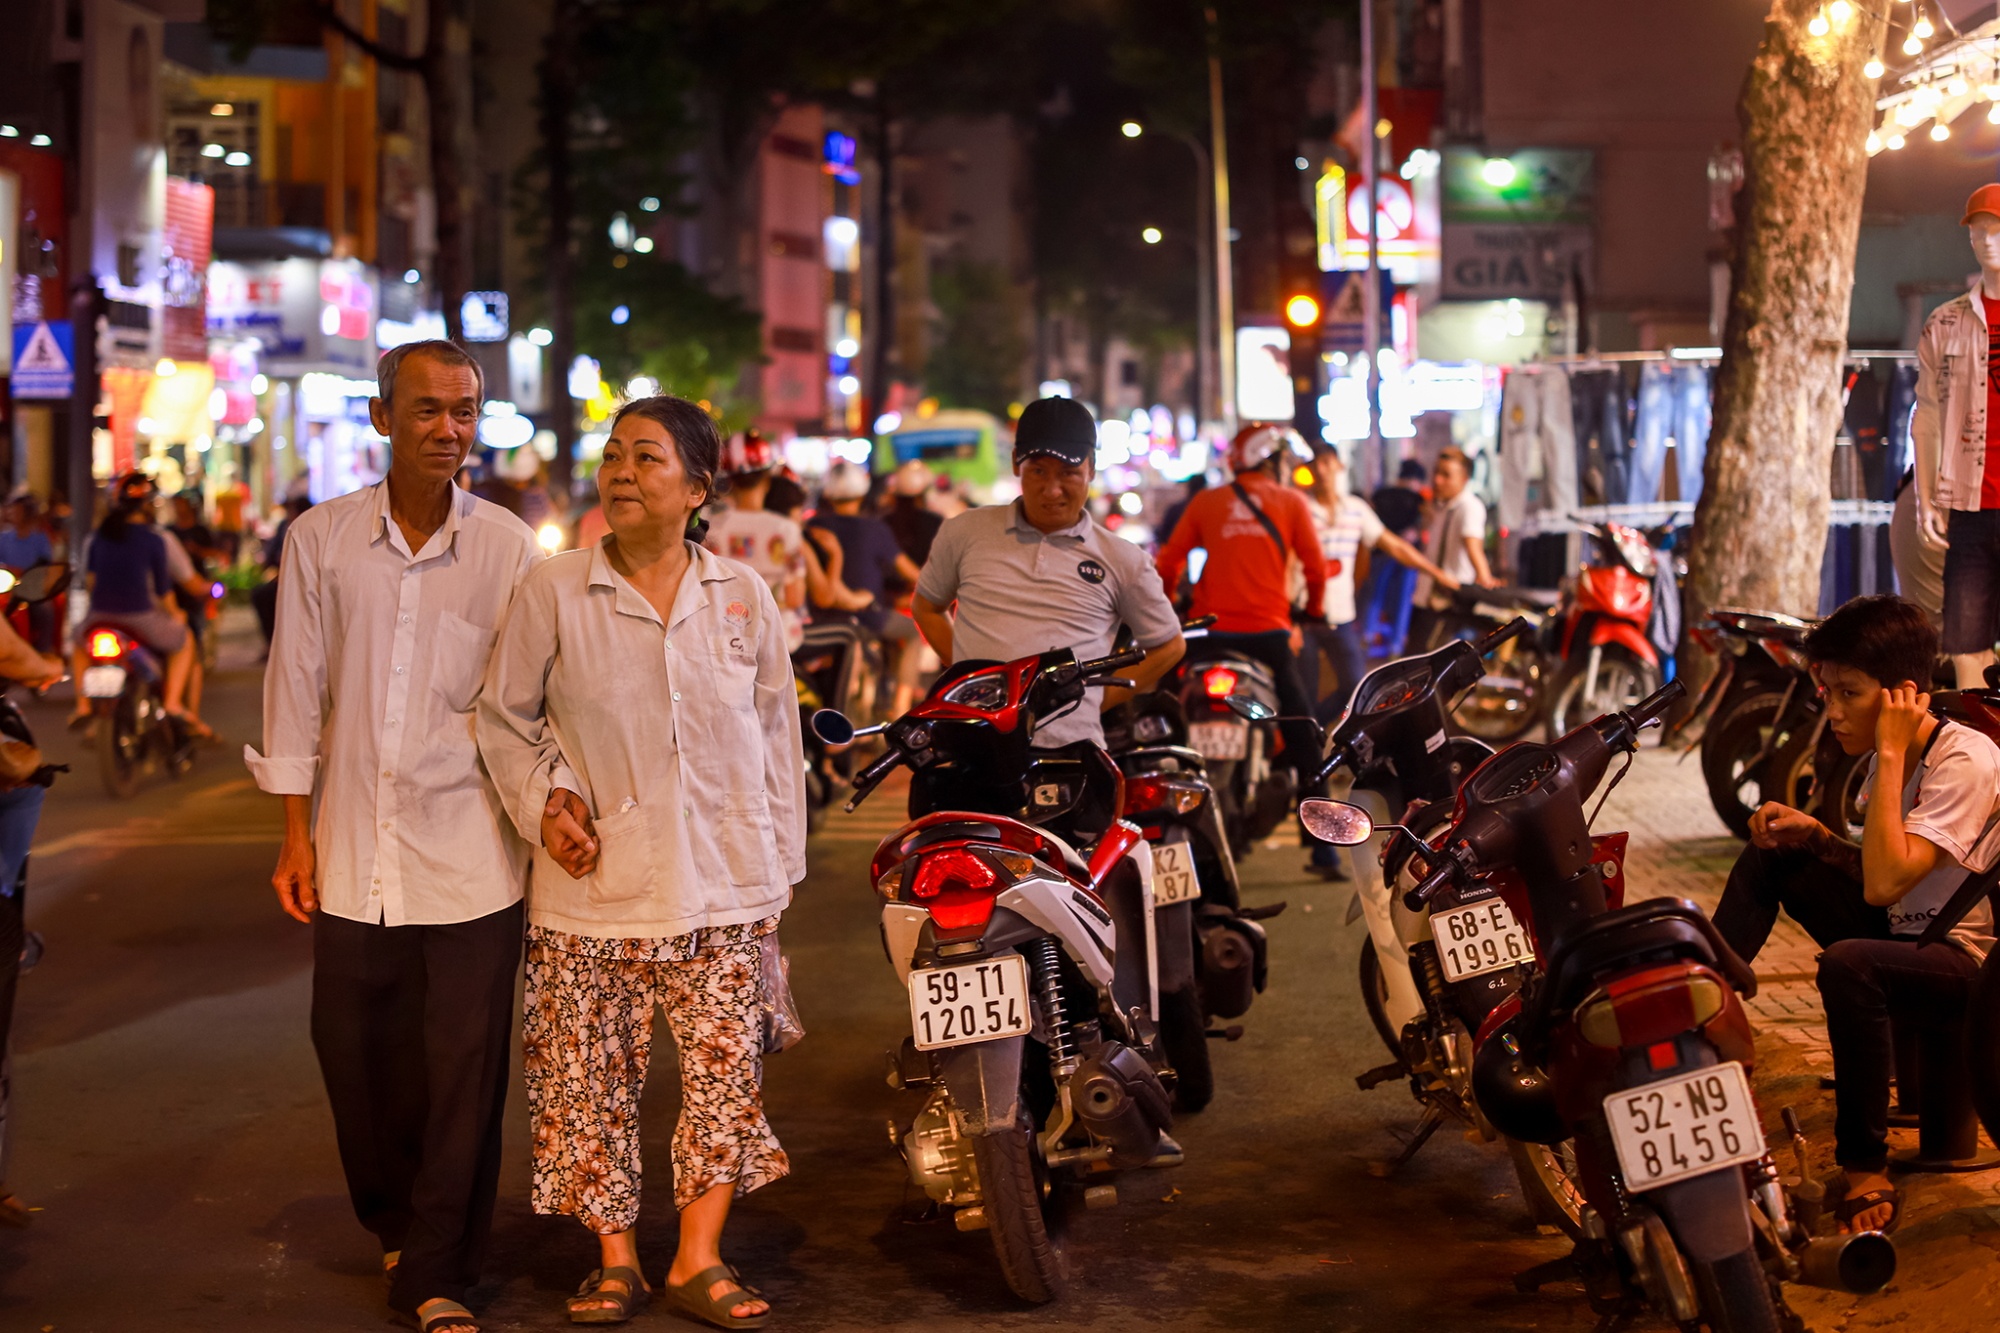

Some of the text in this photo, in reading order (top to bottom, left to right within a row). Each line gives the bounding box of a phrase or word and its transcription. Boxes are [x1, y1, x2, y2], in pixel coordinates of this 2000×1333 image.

[1459, 886, 1493, 900] HONDA
[926, 963, 1004, 1005] 59-T1
[920, 997, 1022, 1043] 120.54
[1626, 1075, 1728, 1134] 52-N9
[1640, 1118, 1741, 1177] 8456
